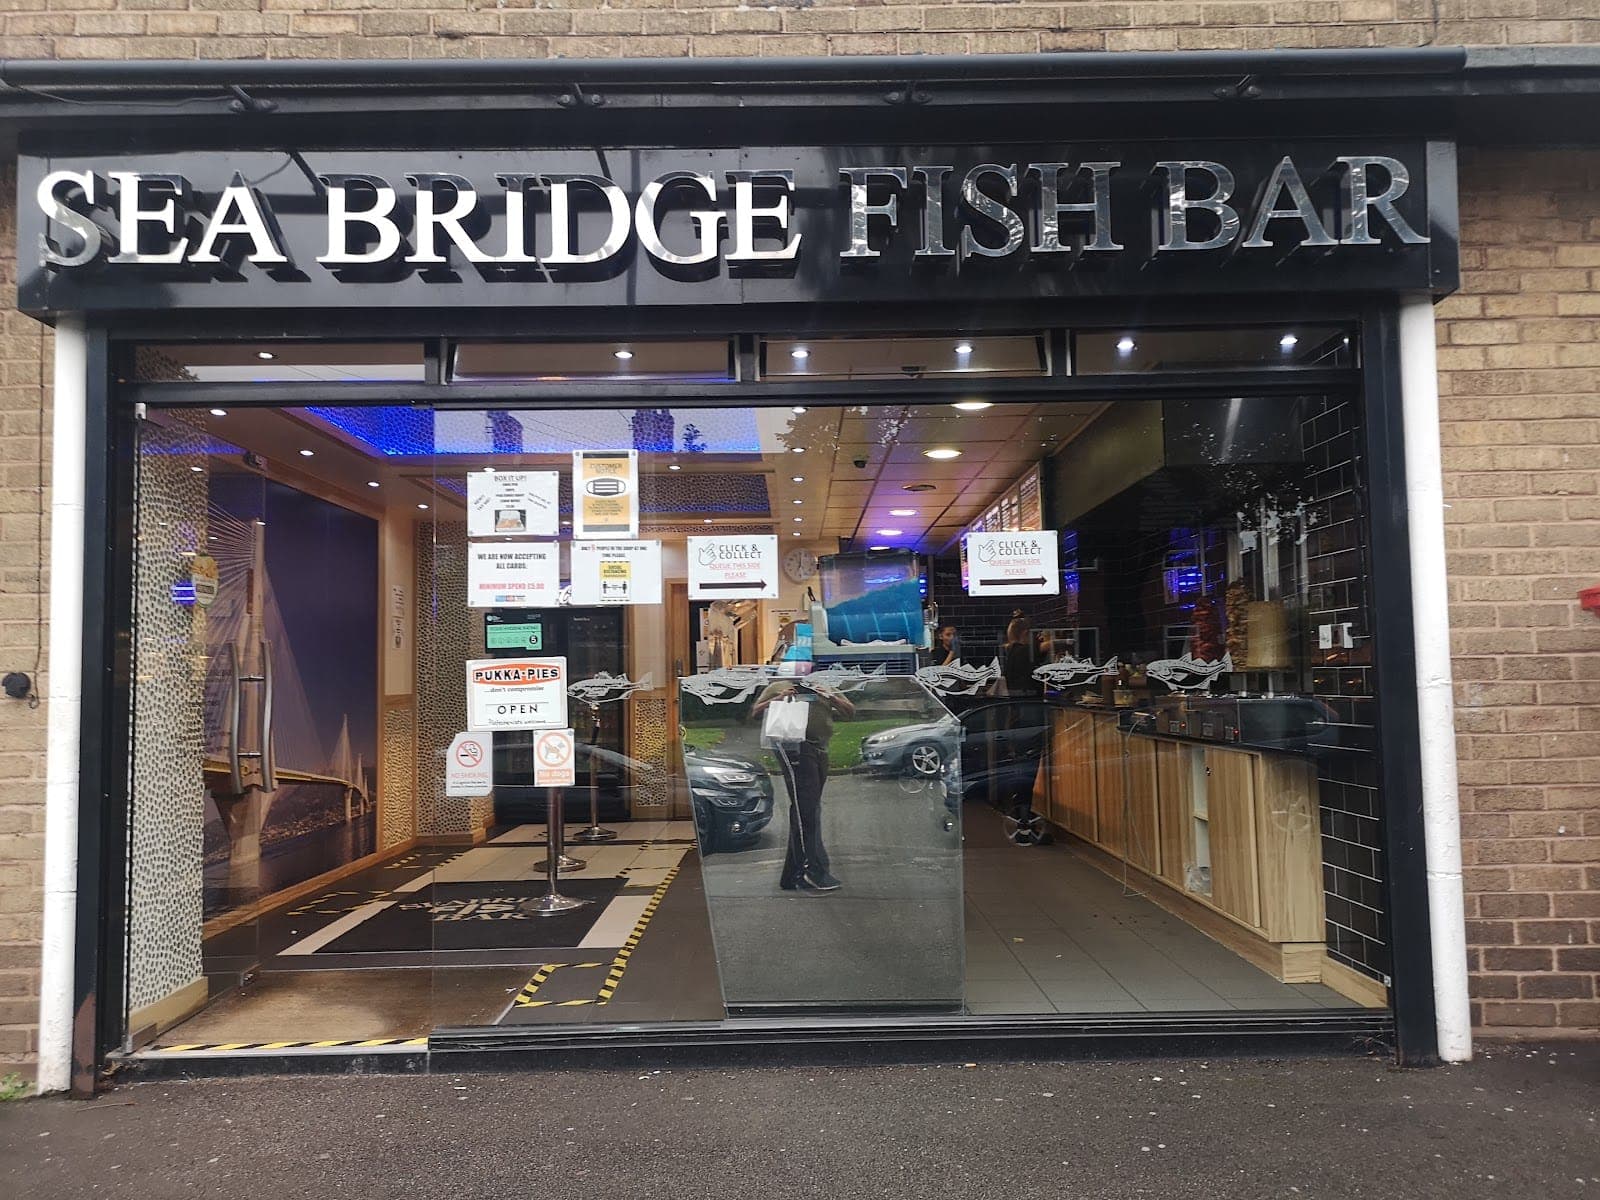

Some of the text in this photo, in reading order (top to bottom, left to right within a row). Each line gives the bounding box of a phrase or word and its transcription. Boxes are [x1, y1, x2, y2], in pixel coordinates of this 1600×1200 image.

[36, 155, 1431, 268] SEA BRIDGE FISH BAR
[719, 543, 758, 552] CLICK &
[1031, 540, 1038, 548] &
[498, 704, 538, 714] OPEN
